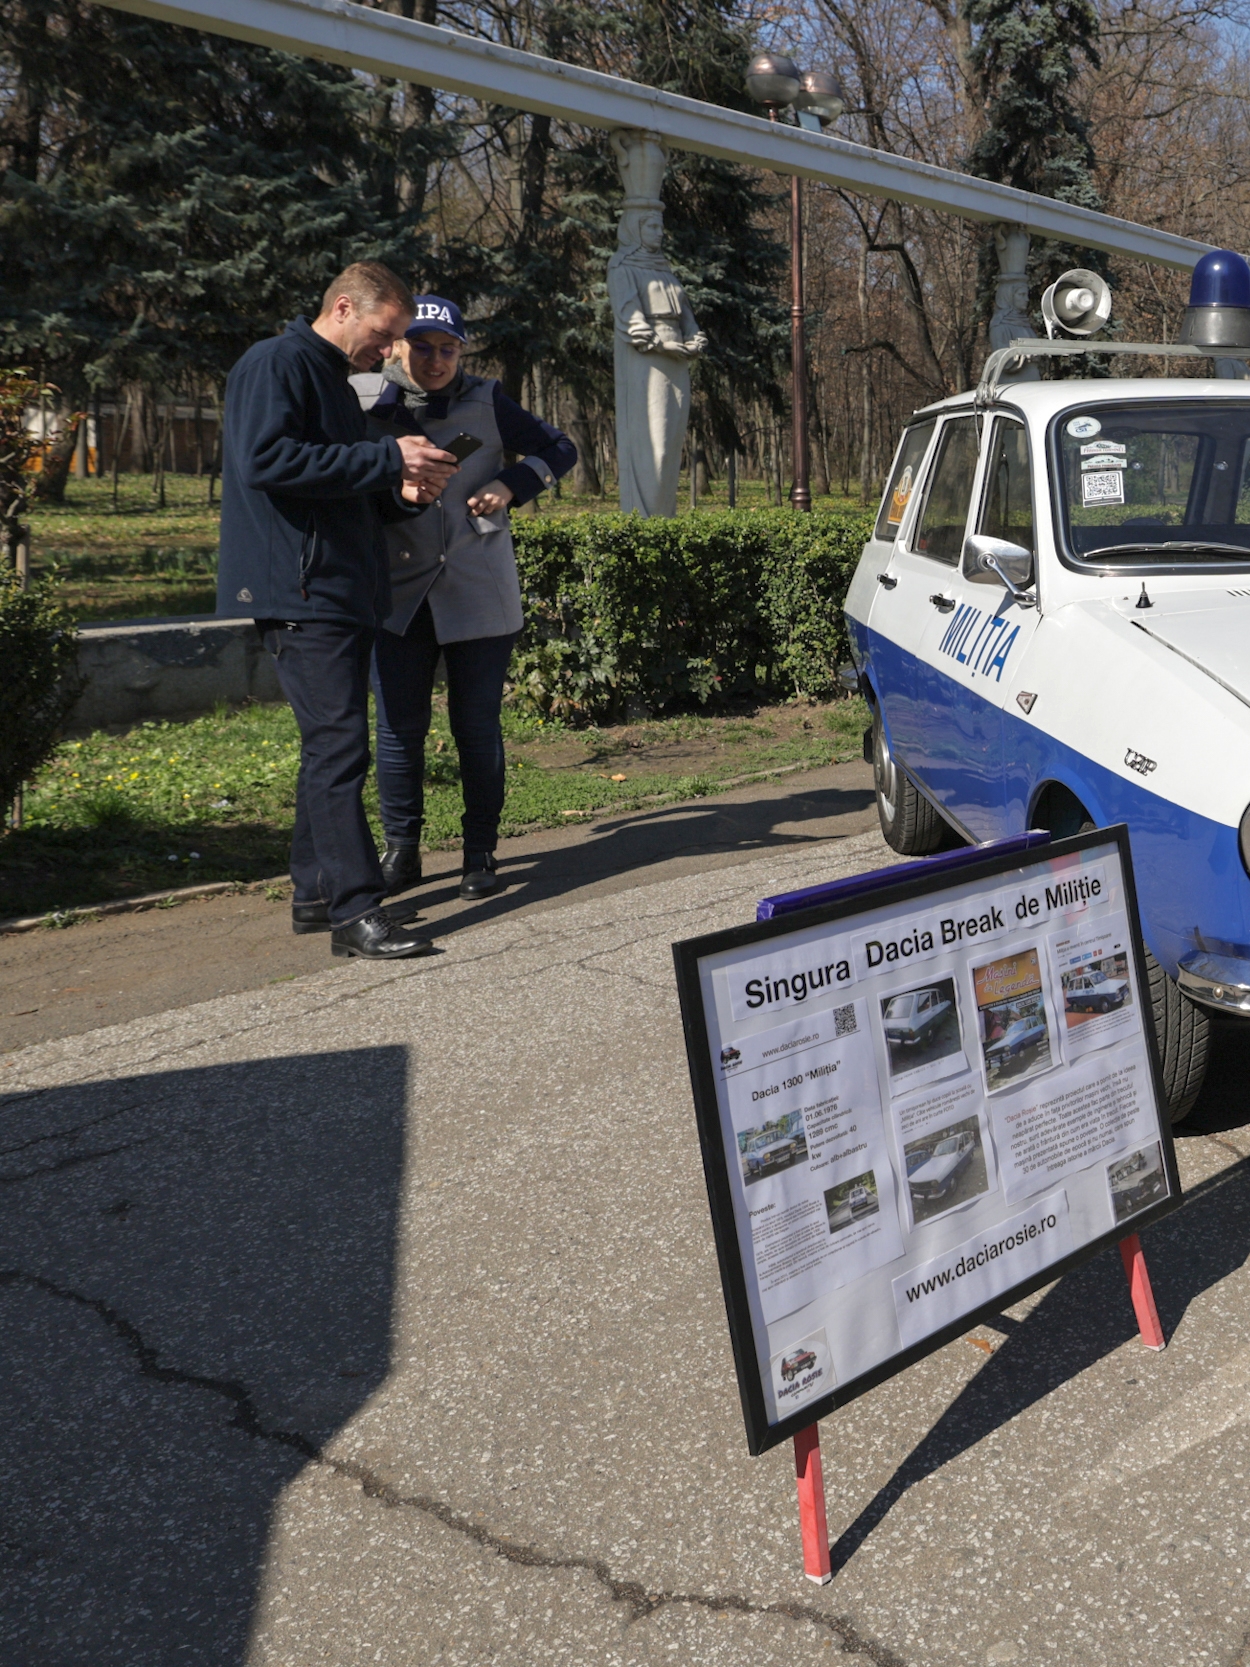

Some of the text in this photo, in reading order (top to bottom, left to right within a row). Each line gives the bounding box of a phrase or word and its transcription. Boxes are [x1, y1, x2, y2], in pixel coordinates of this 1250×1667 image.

[416, 304, 454, 325] IPA
[939, 603, 1021, 682] MILIȚIA
[746, 877, 1101, 1008] Singura Dacia Break de Miliție
[762, 1033, 819, 1057] www.daciarosie.ro
[752, 1086, 779, 1101] Dacia
[782, 1075, 803, 1089] 1300
[1040, 1094, 1065, 1108] reprezintă
[1065, 1086, 1085, 1100] proiectul
[805, 1104, 838, 1121] 01.06.1976
[1028, 1113, 1044, 1124] aduce
[809, 1123, 838, 1139] 1289 cmc
[830, 1144, 867, 1163] alb+albastru
[1022, 1166, 1029, 1174] 30
[1037, 1152, 1063, 1167] automobile
[749, 1204, 775, 1220] Poveste:
[906, 1214, 1056, 1302] www.daciarosie.ro
[778, 1382, 800, 1399] DACIA
